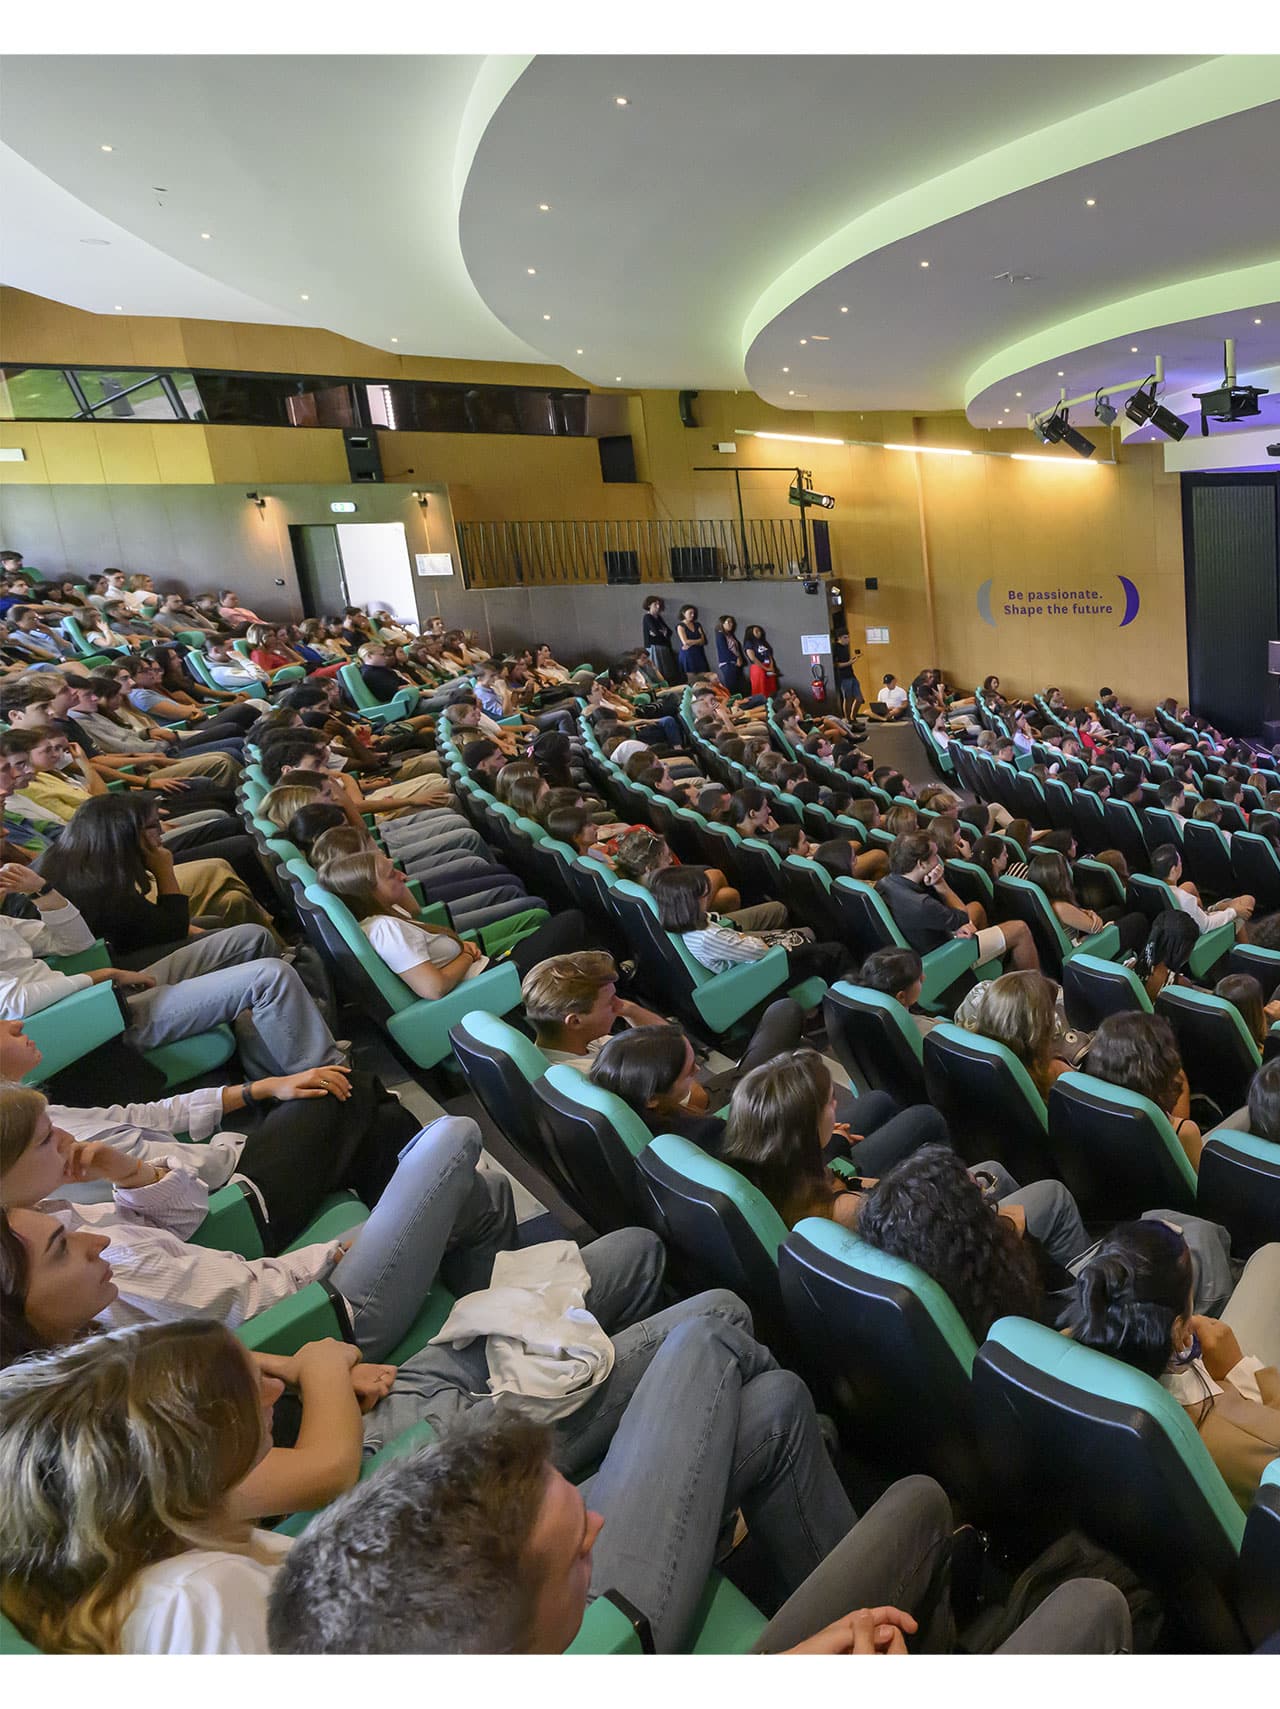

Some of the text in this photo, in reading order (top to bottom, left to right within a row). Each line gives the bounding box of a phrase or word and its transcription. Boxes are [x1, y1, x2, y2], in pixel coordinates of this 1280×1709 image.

[1008, 589, 1103, 602] Be passionate.
[1004, 603, 1112, 617] Shape the future
